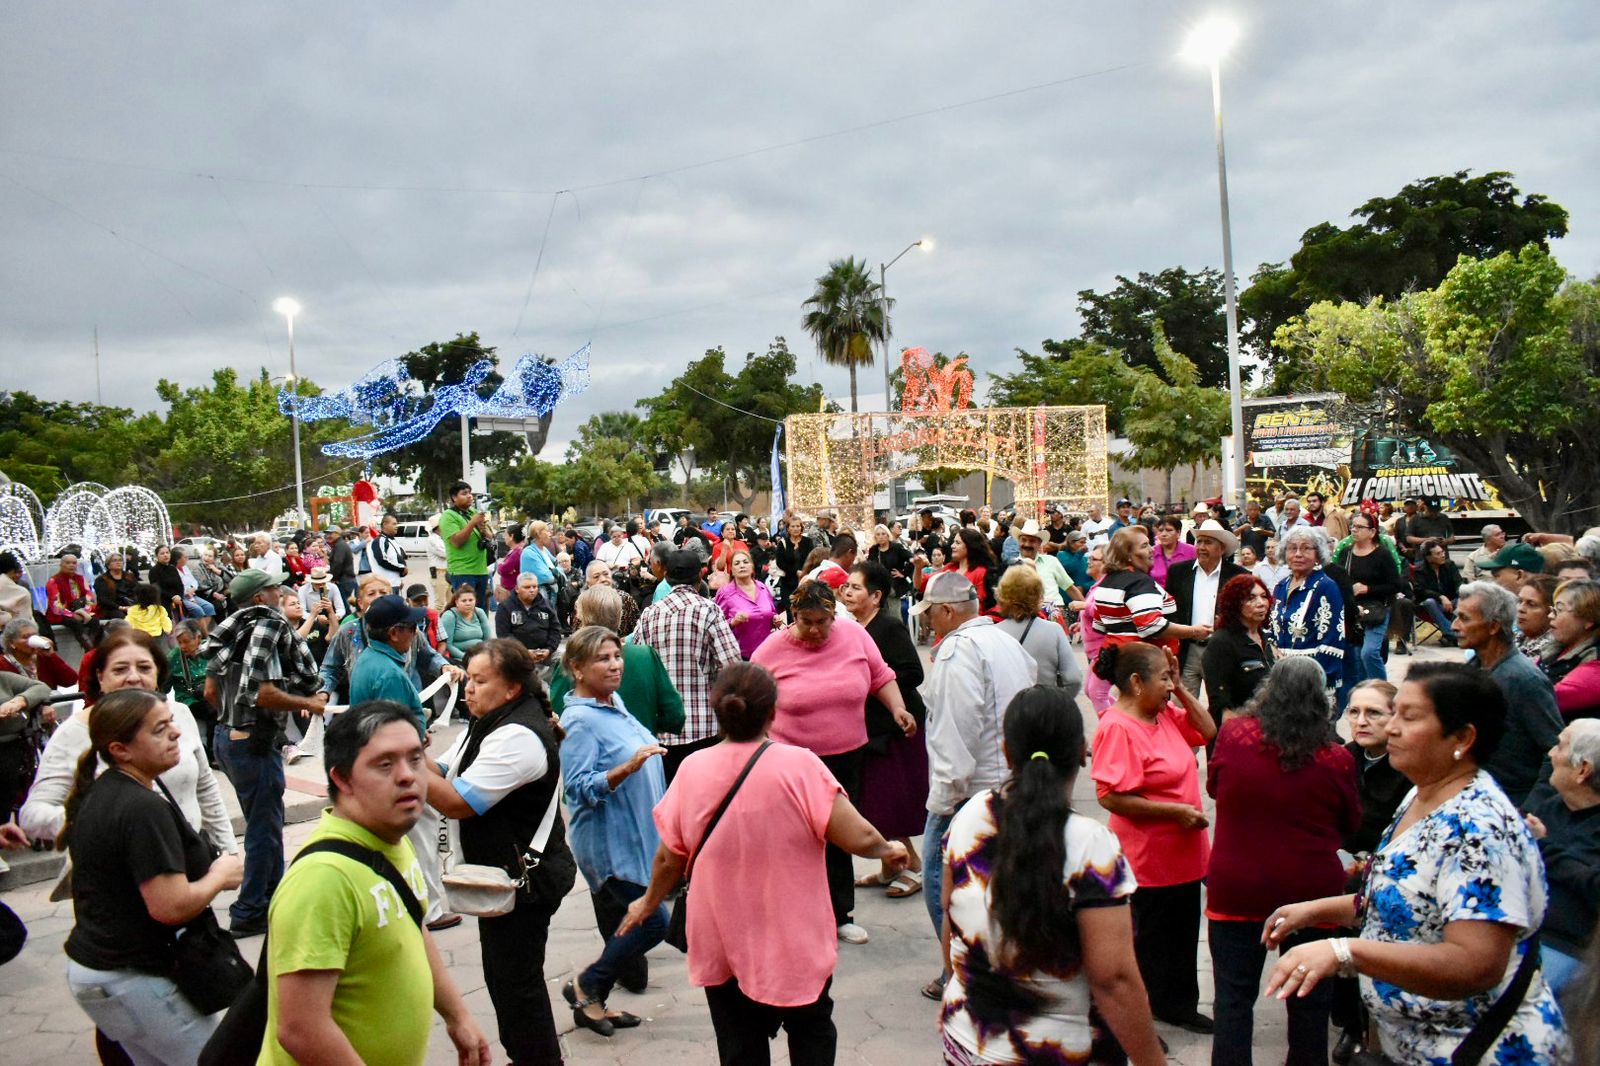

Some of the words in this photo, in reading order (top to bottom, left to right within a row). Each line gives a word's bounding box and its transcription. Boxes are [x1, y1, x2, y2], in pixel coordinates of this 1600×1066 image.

[1376, 467, 1449, 477] DISCOMOVIL
[1340, 478, 1363, 506] EL
[1362, 473, 1489, 501] COMERCIANTE
